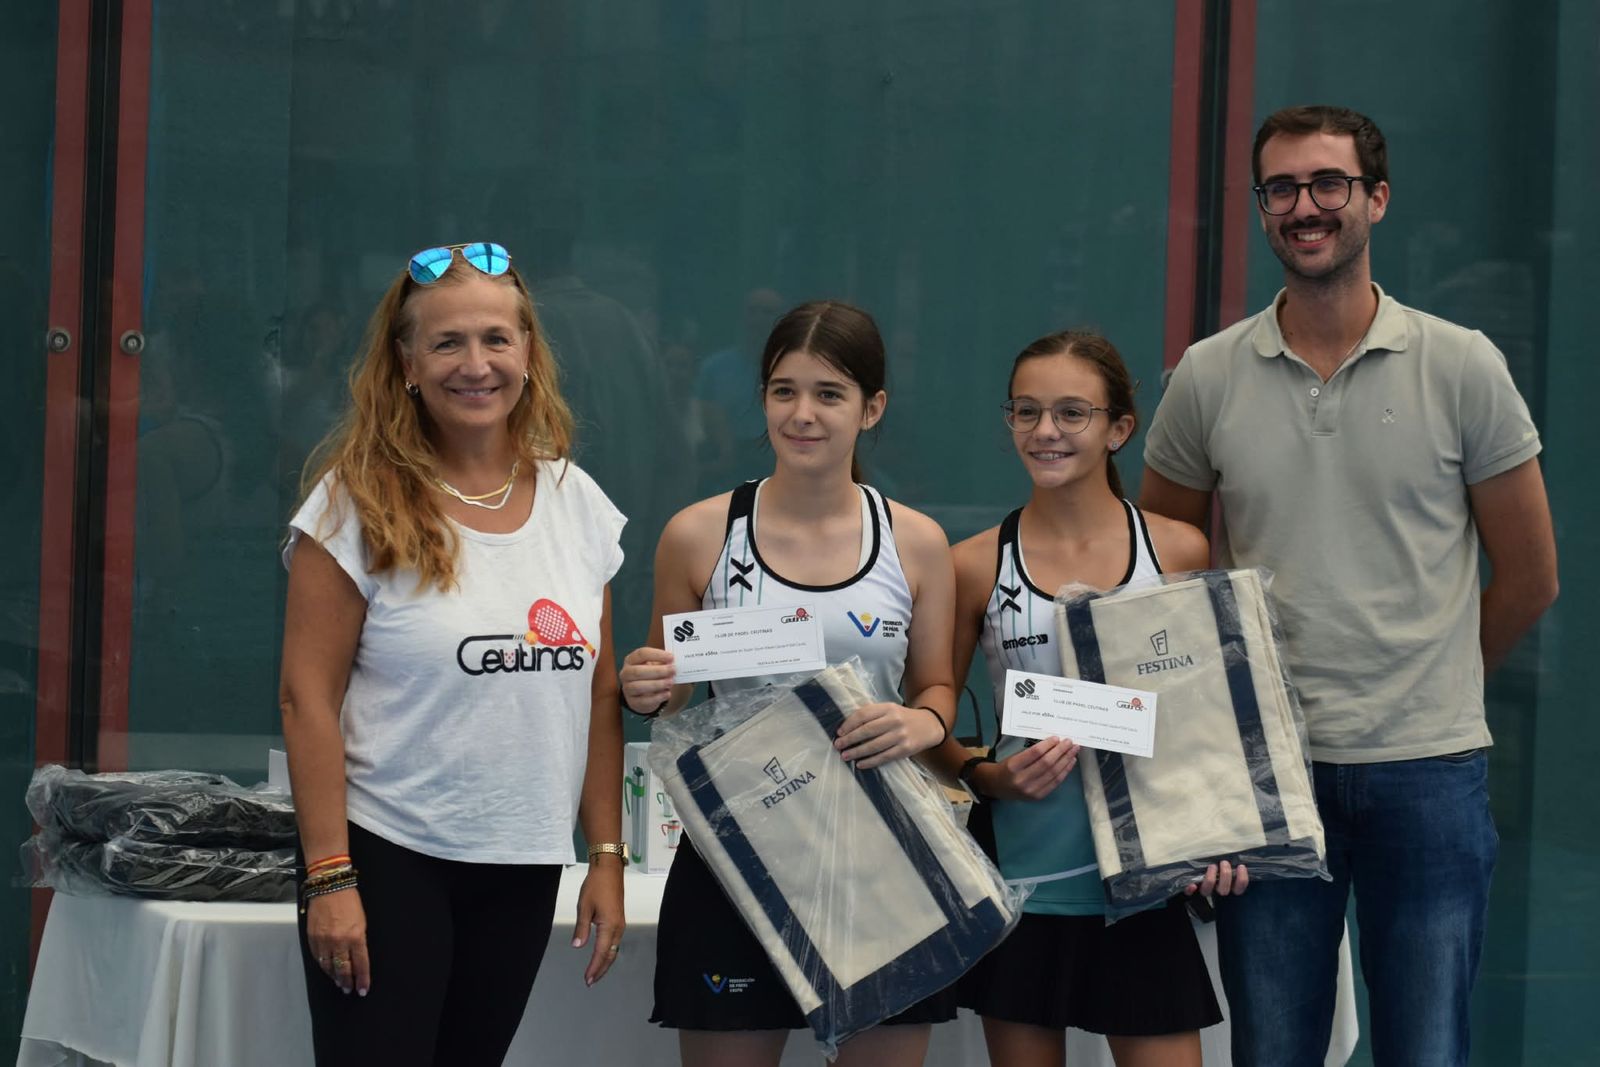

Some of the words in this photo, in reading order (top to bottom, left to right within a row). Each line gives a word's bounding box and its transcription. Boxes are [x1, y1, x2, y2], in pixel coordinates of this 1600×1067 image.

[457, 634, 584, 676] Ceutinas
[1137, 654, 1194, 675] FESTINA
[762, 770, 816, 809] FESTINA
